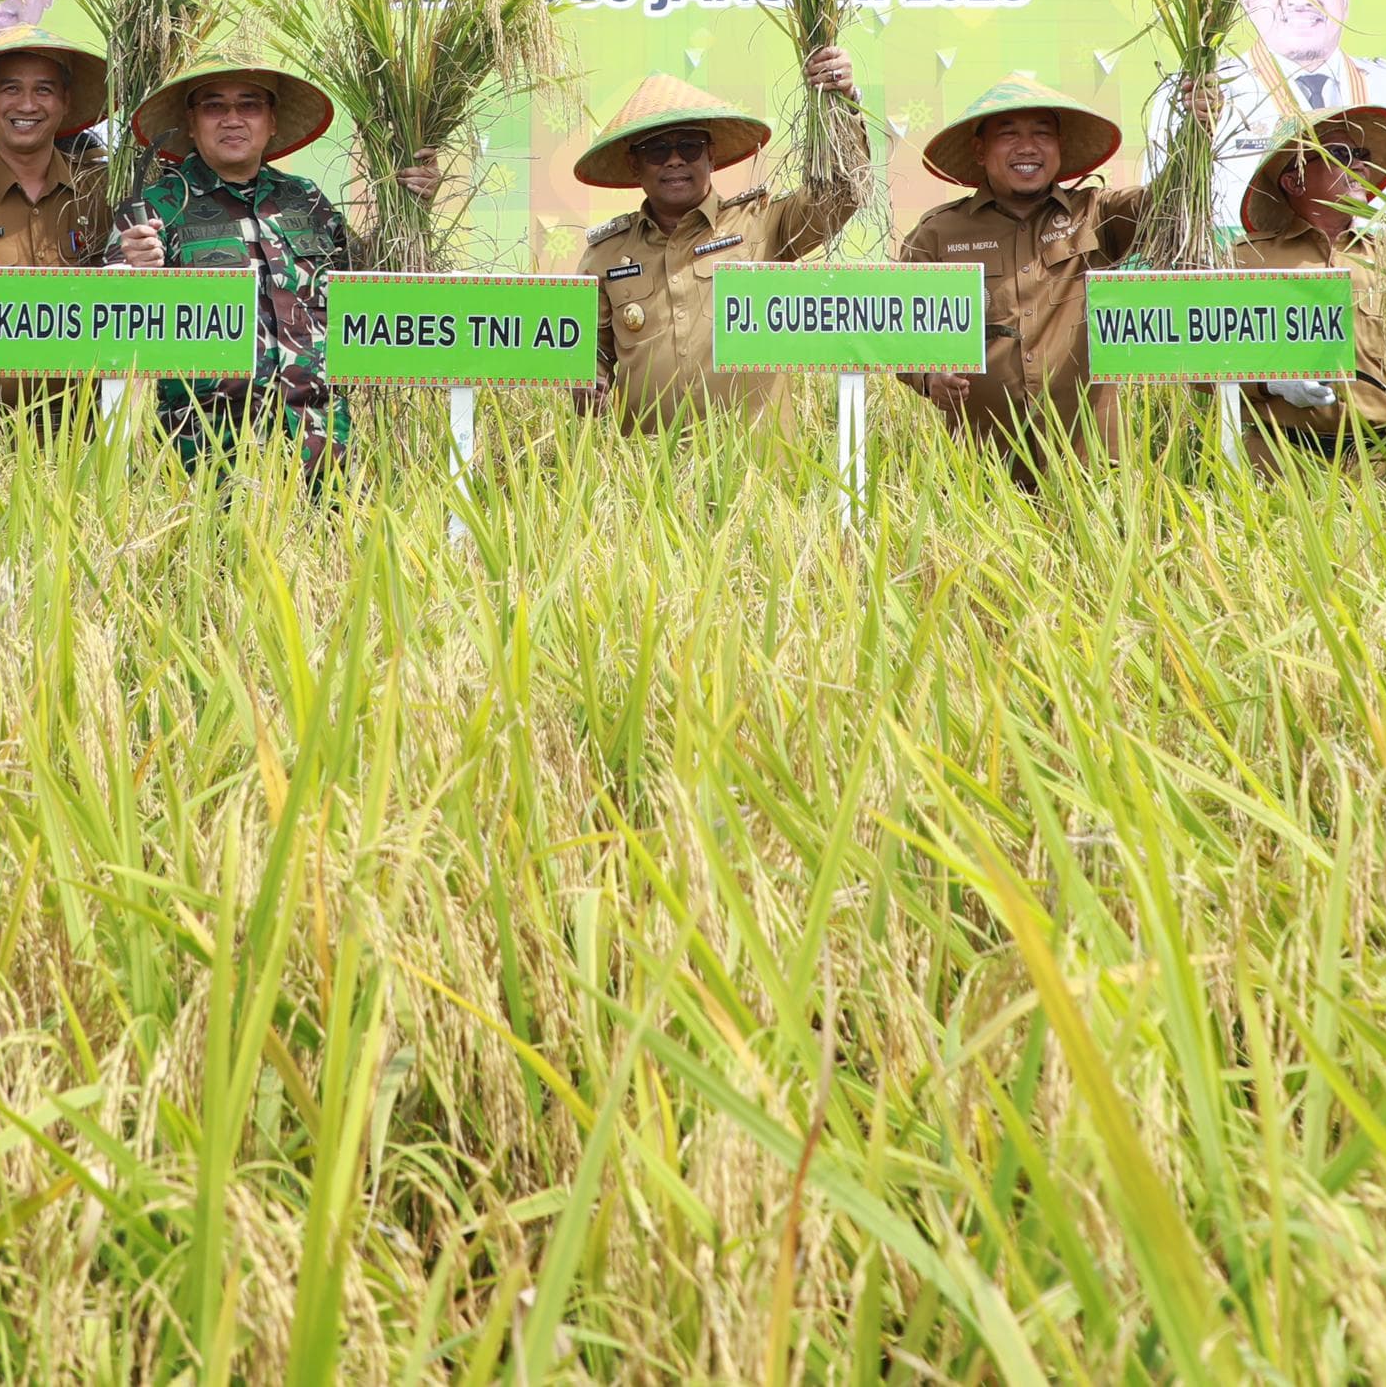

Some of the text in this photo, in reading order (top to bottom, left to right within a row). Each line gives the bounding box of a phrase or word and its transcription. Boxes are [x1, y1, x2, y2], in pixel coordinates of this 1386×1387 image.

[947, 241, 999, 253] HUSNI MERZA
[92, 303, 165, 340] PTPH
[175, 303, 244, 341] RIAU
[342, 313, 581, 349] MABES TNI AD
[726, 295, 971, 333] PJ. GUBERNUR RIAU
[1095, 305, 1345, 345] WAKIL BUPATI SIAK
